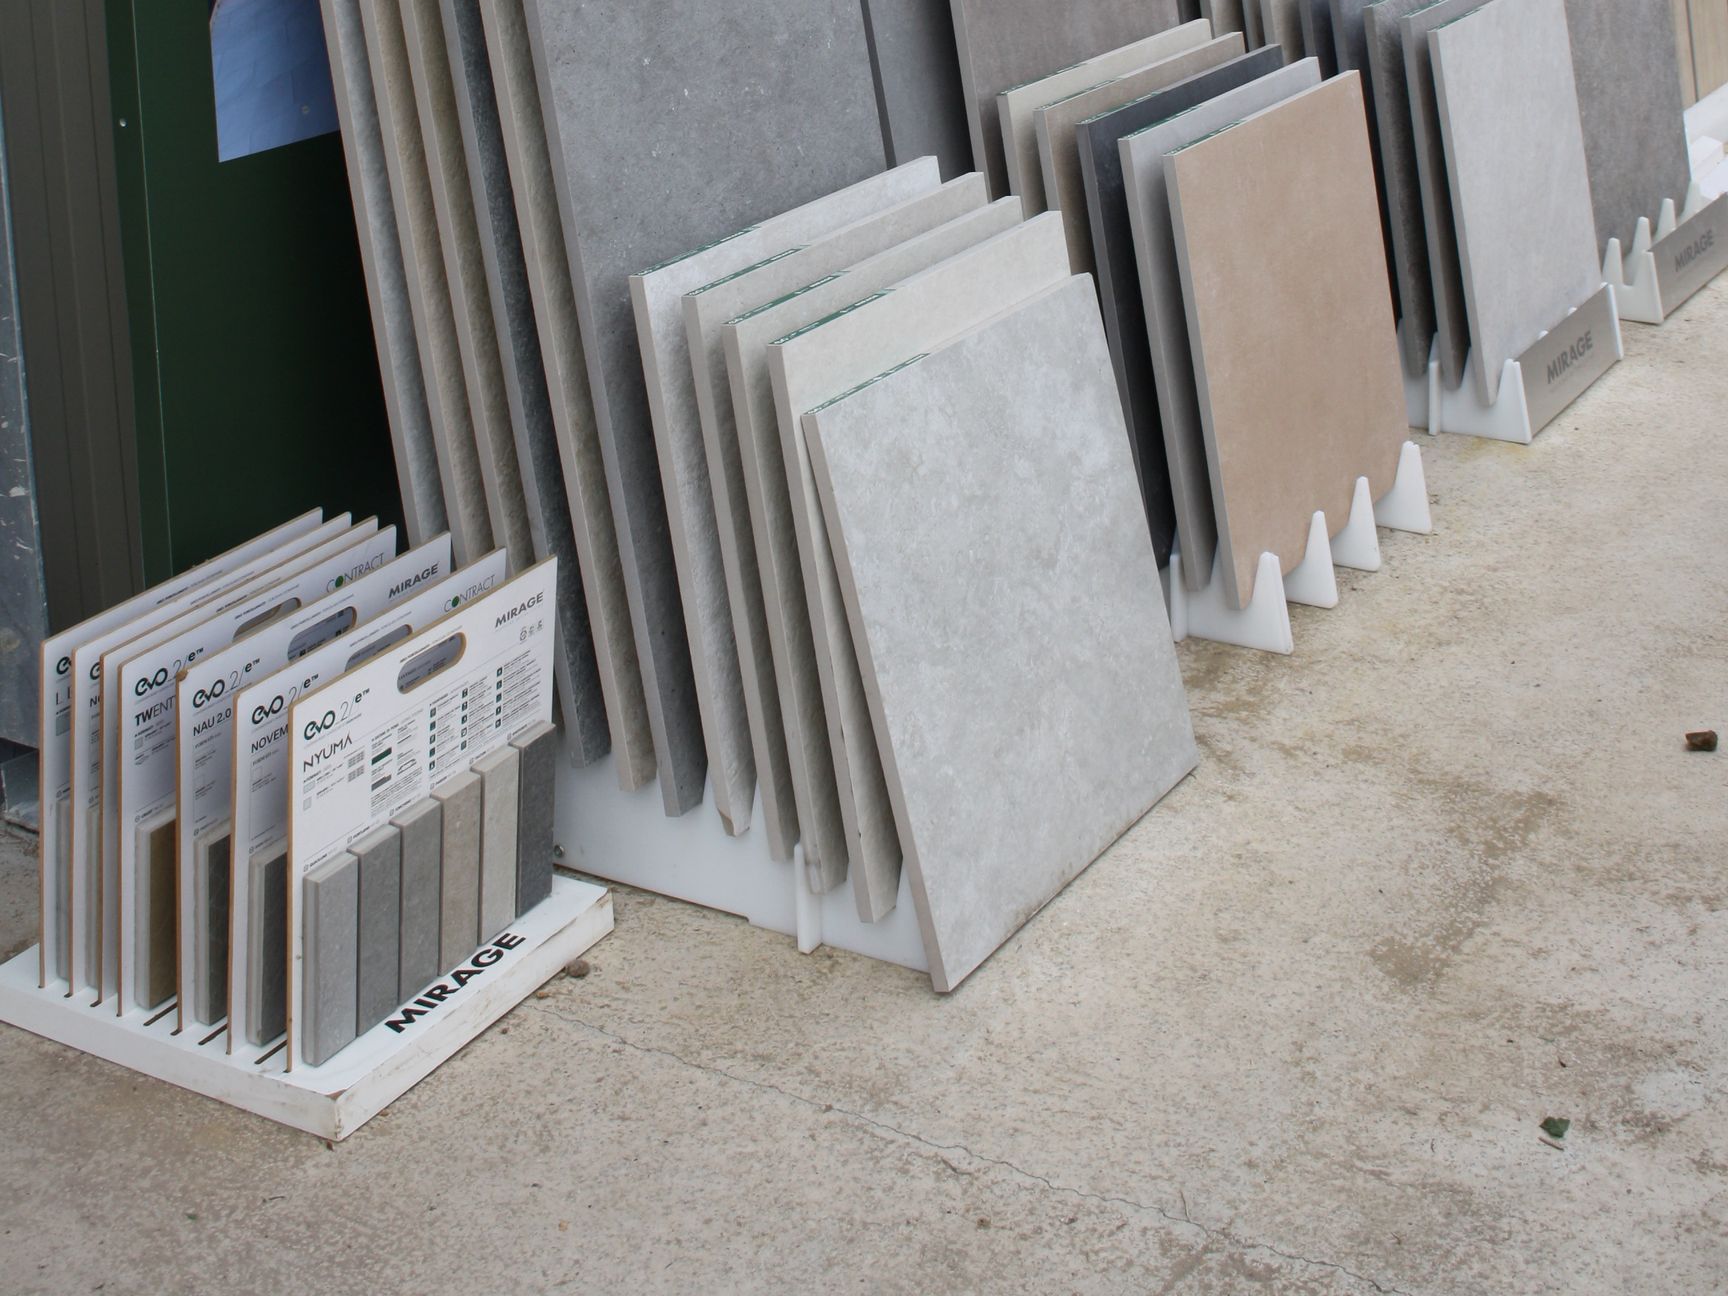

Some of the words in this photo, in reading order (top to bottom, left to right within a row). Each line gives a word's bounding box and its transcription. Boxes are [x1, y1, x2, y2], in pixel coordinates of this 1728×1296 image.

[1675, 229, 1714, 272] MIRAGE
[1547, 330, 1593, 384] MIRAGE
[388, 563, 440, 599] MIRAGE
[495, 591, 544, 628] MIRAGE
[134, 694, 176, 726] TWENT
[193, 716, 215, 736] NAU
[217, 707, 232, 724] 2.0
[384, 933, 526, 1034] MIRAGE
